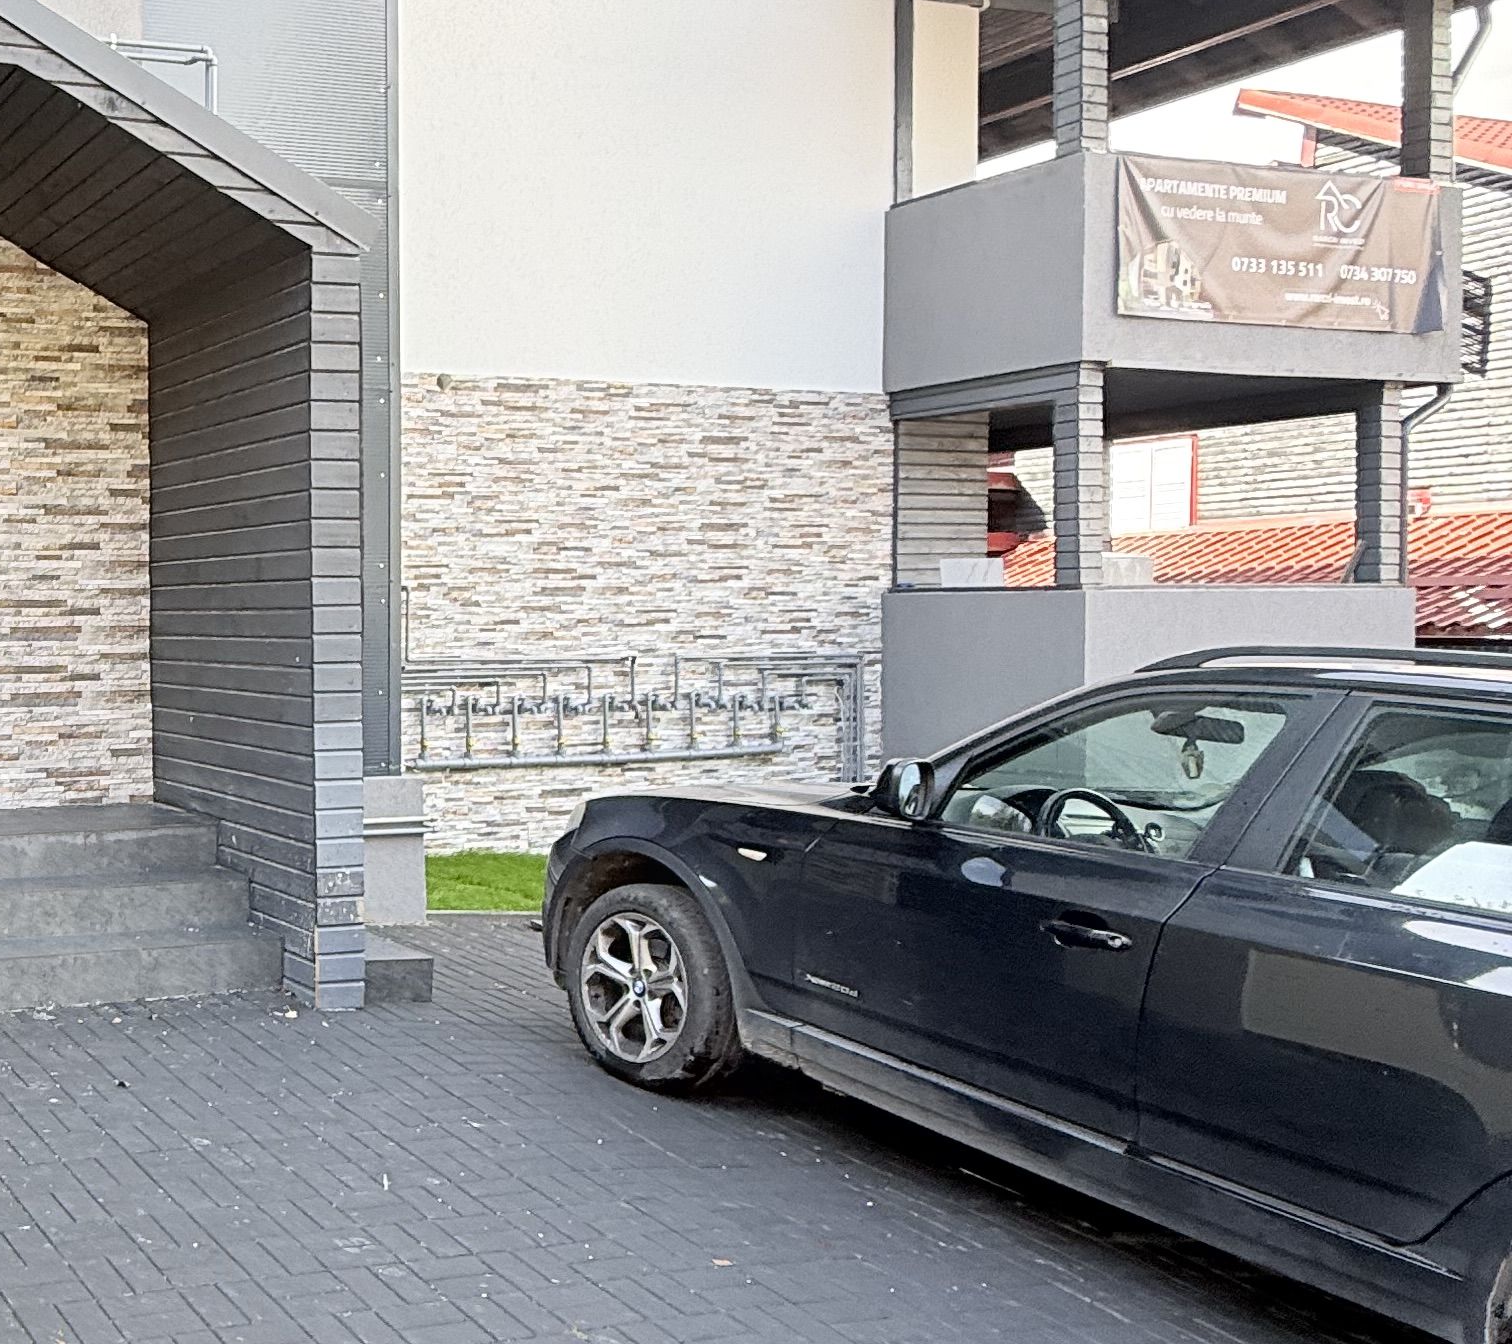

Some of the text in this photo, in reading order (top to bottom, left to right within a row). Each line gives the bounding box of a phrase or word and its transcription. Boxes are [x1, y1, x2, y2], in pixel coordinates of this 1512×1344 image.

[1229, 185, 1287, 204] PREMIUM
[1160, 205, 1264, 225] cu vedere la munte
[1231, 257, 1323, 277] 0733 135 511
[1340, 264, 1417, 284] 0734 307 750
